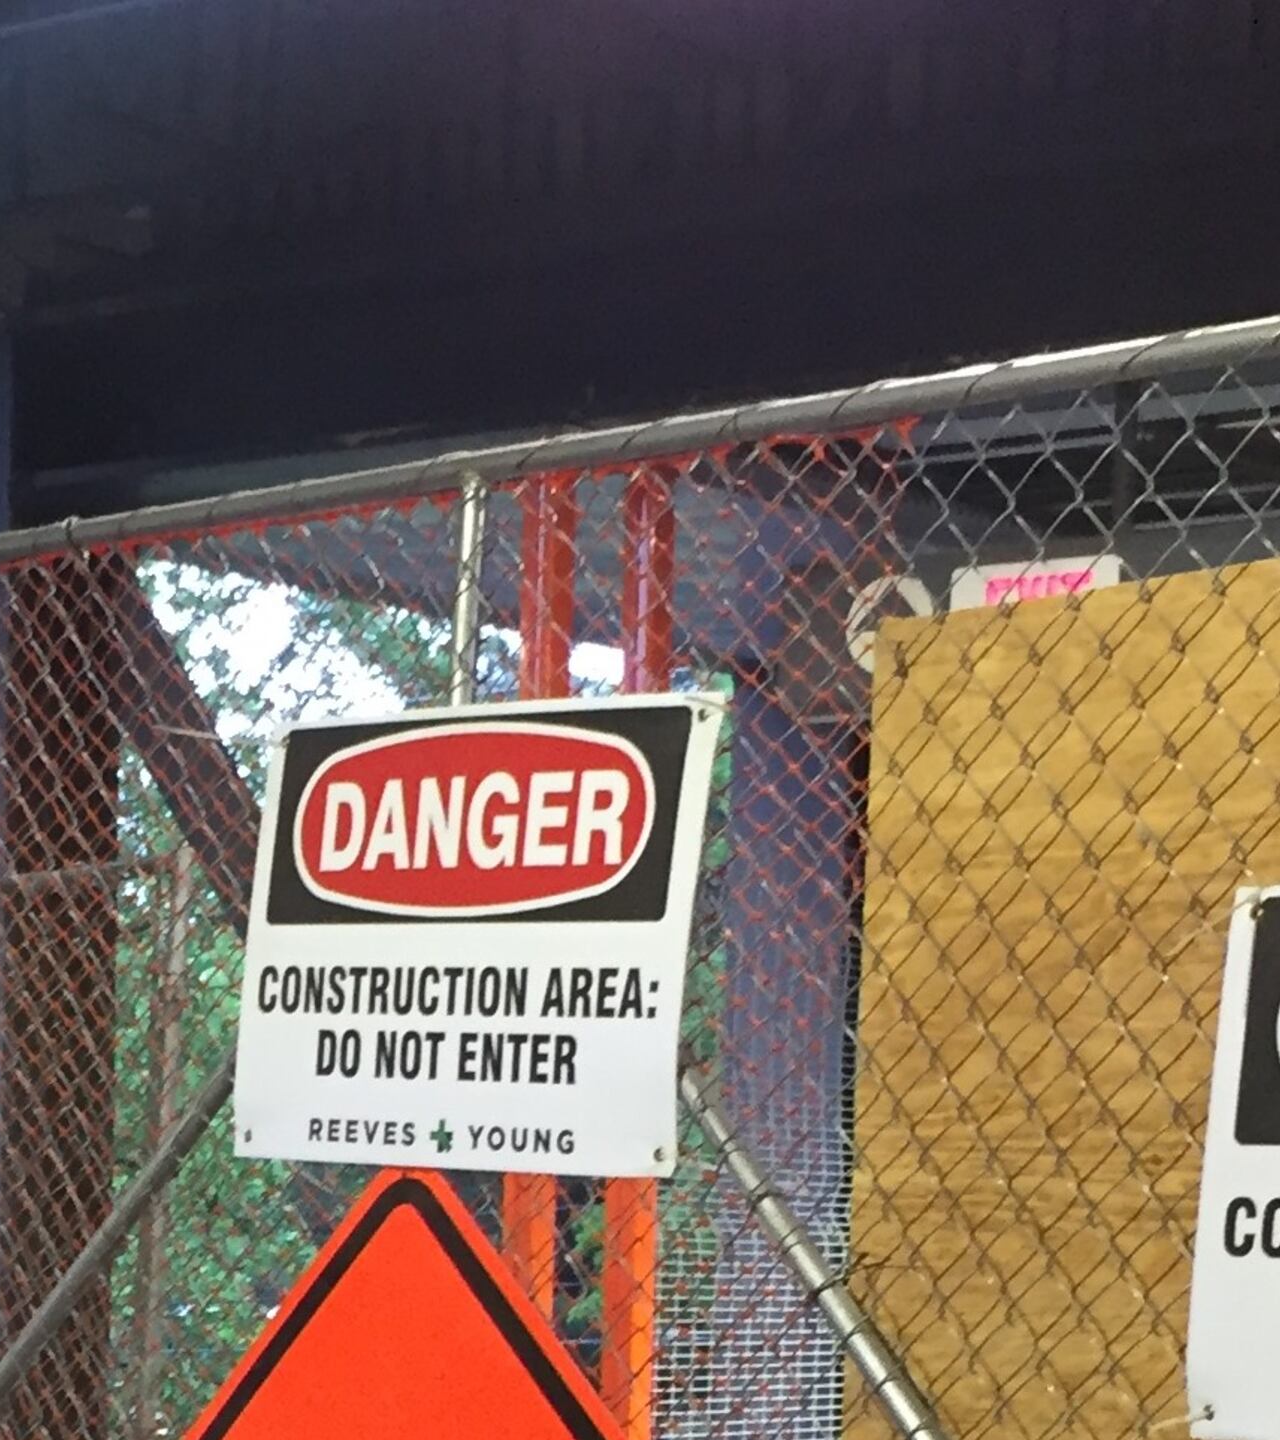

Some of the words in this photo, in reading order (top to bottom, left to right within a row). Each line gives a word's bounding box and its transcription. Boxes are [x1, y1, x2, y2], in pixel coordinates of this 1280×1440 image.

[319, 767, 631, 873] DANGER
[258, 965, 528, 1017] CONSTRUCTION
[540, 967, 660, 1019] AREA:
[316, 1029, 361, 1078] DO
[374, 1030, 446, 1080] NOT
[457, 1032, 578, 1085] ENTER
[308, 1118, 416, 1147] REEVES
[468, 1124, 576, 1155] YOUNG
